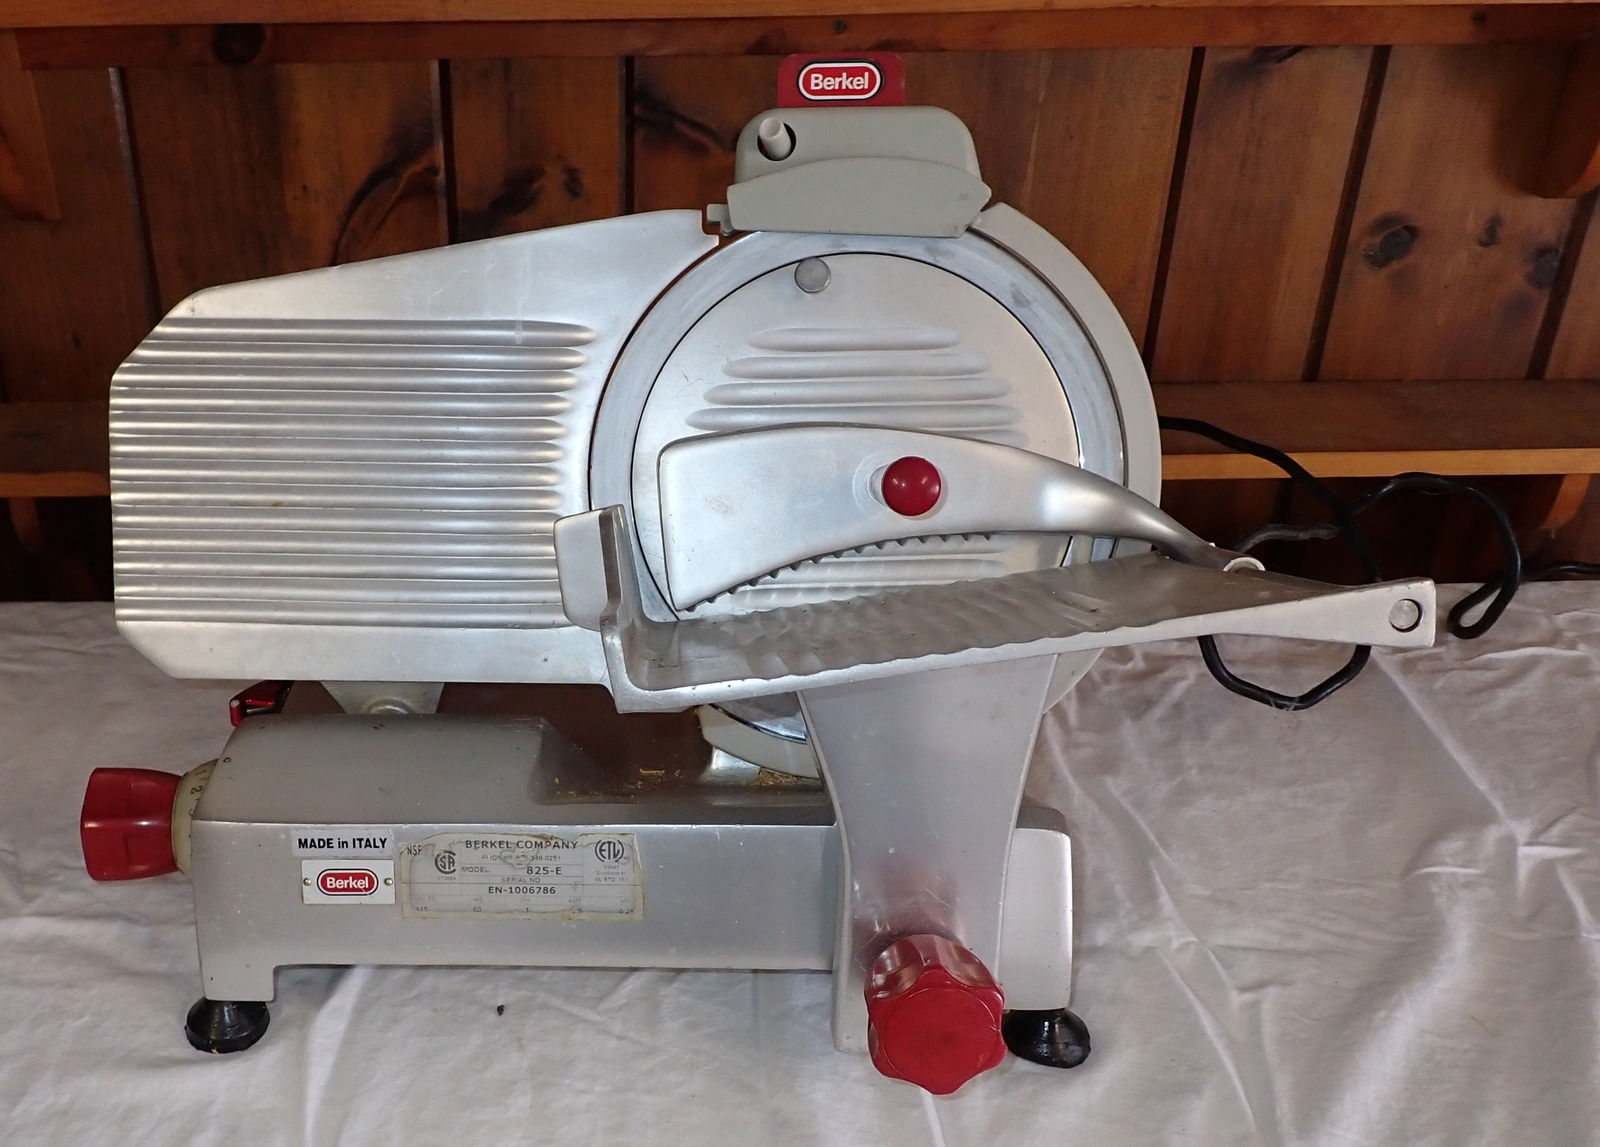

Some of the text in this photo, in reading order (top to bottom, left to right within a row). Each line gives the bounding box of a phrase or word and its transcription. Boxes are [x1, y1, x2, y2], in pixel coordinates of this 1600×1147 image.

[810, 72, 869, 91] Berkel
[298, 838, 388, 849] MADE in ITALY
[466, 840, 578, 850] BERKEL COMPANY
[461, 866, 562, 876] MODEL 825-E
[326, 875, 369, 889] Berkel
[488, 886, 556, 895] EN-1006786
